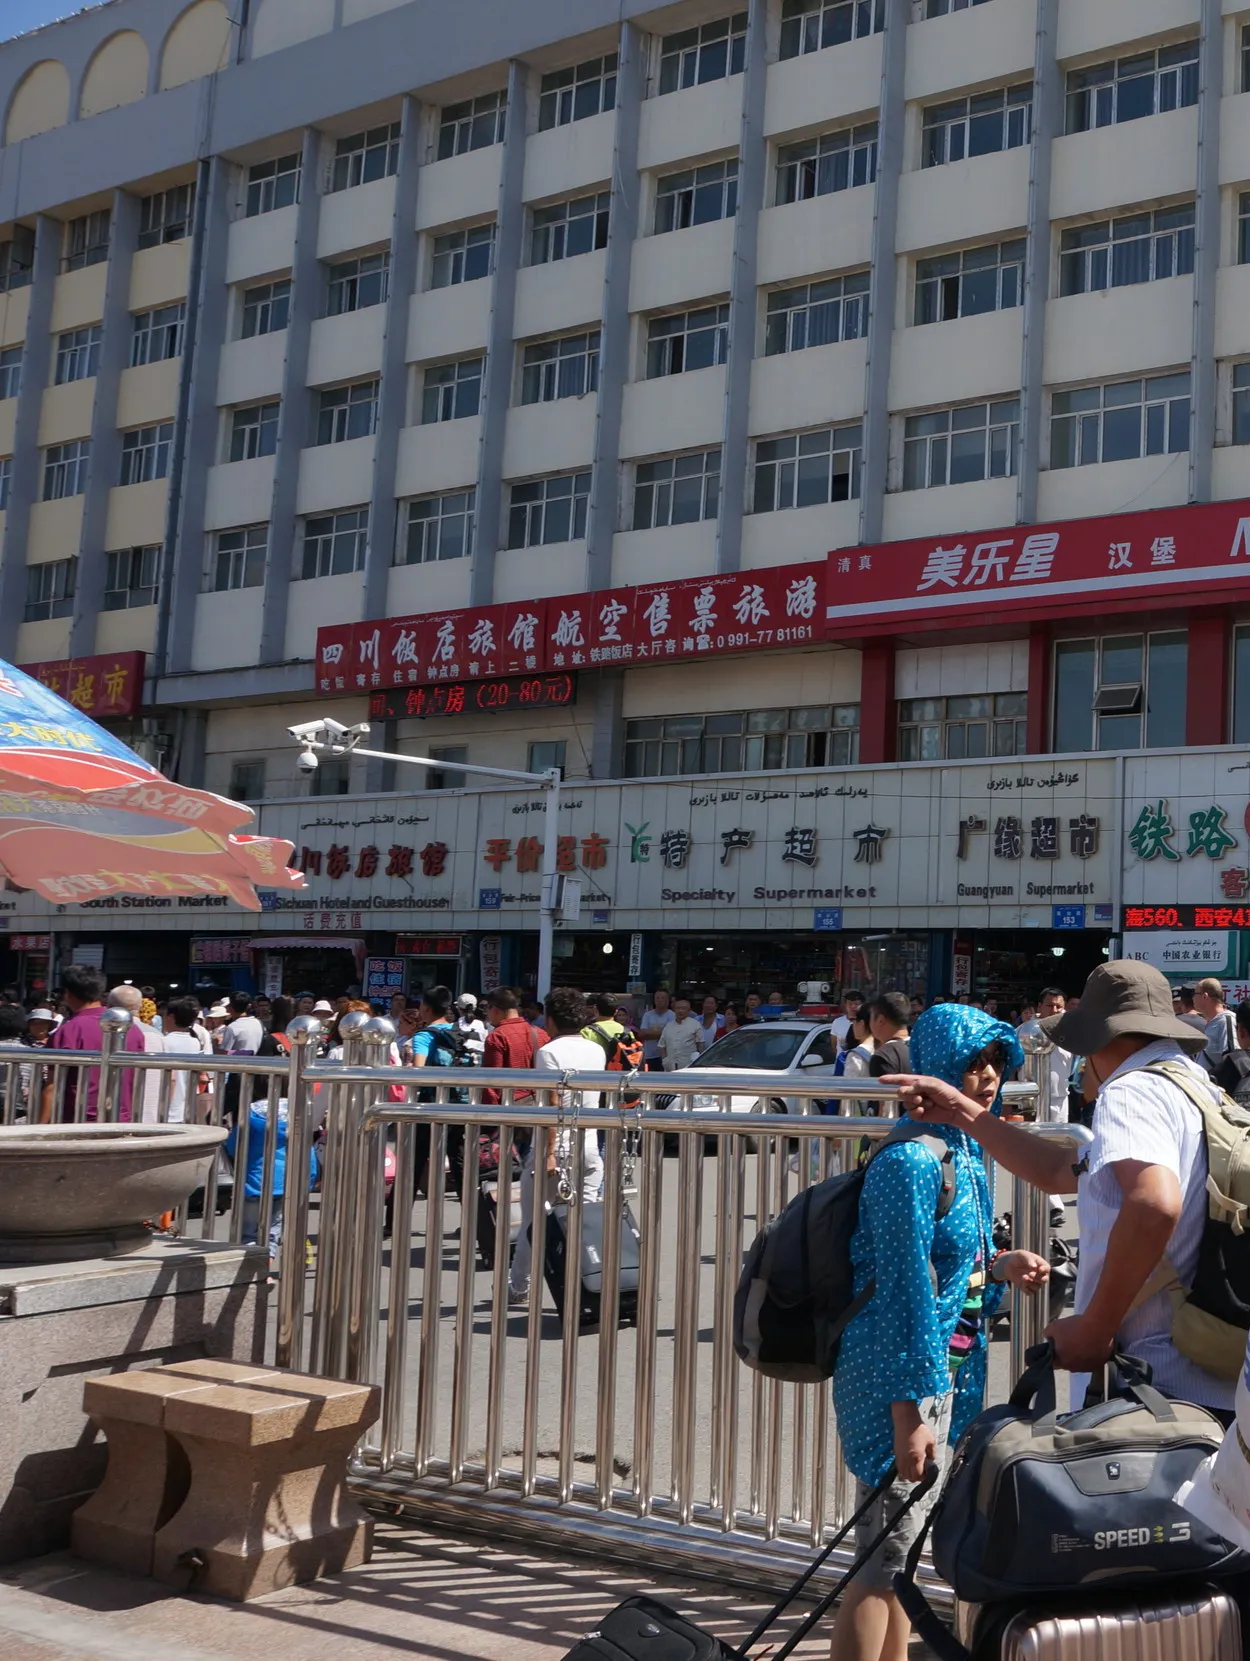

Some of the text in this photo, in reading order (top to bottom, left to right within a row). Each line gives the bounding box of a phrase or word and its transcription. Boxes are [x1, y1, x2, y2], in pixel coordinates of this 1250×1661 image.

[836, 532, 1177, 592] 清真 美乐星 汉堡
[393, 668, 417, 683] 住宿
[427, 663, 460, 678] 钟点房
[956, 813, 1100, 861] 广缘超市
[660, 824, 890, 869] 特产超市
[661, 886, 877, 903] Specialty Supermarket
[957, 882, 1094, 899] Guangyuan Supermarket
[121, 895, 171, 908] Station
[178, 893, 228, 907] Market
[276, 896, 318, 909] Sichuan
[319, 895, 349, 909] Hotel
[351, 895, 372, 909] and
[373, 895, 447, 909] Guesthouse
[303, 911, 363, 930] 话费充值
[1126, 950, 1150, 961] ABC
[1162, 949, 1222, 961] 中国农业银行
[1093, 1527, 1151, 1550] SPEED
